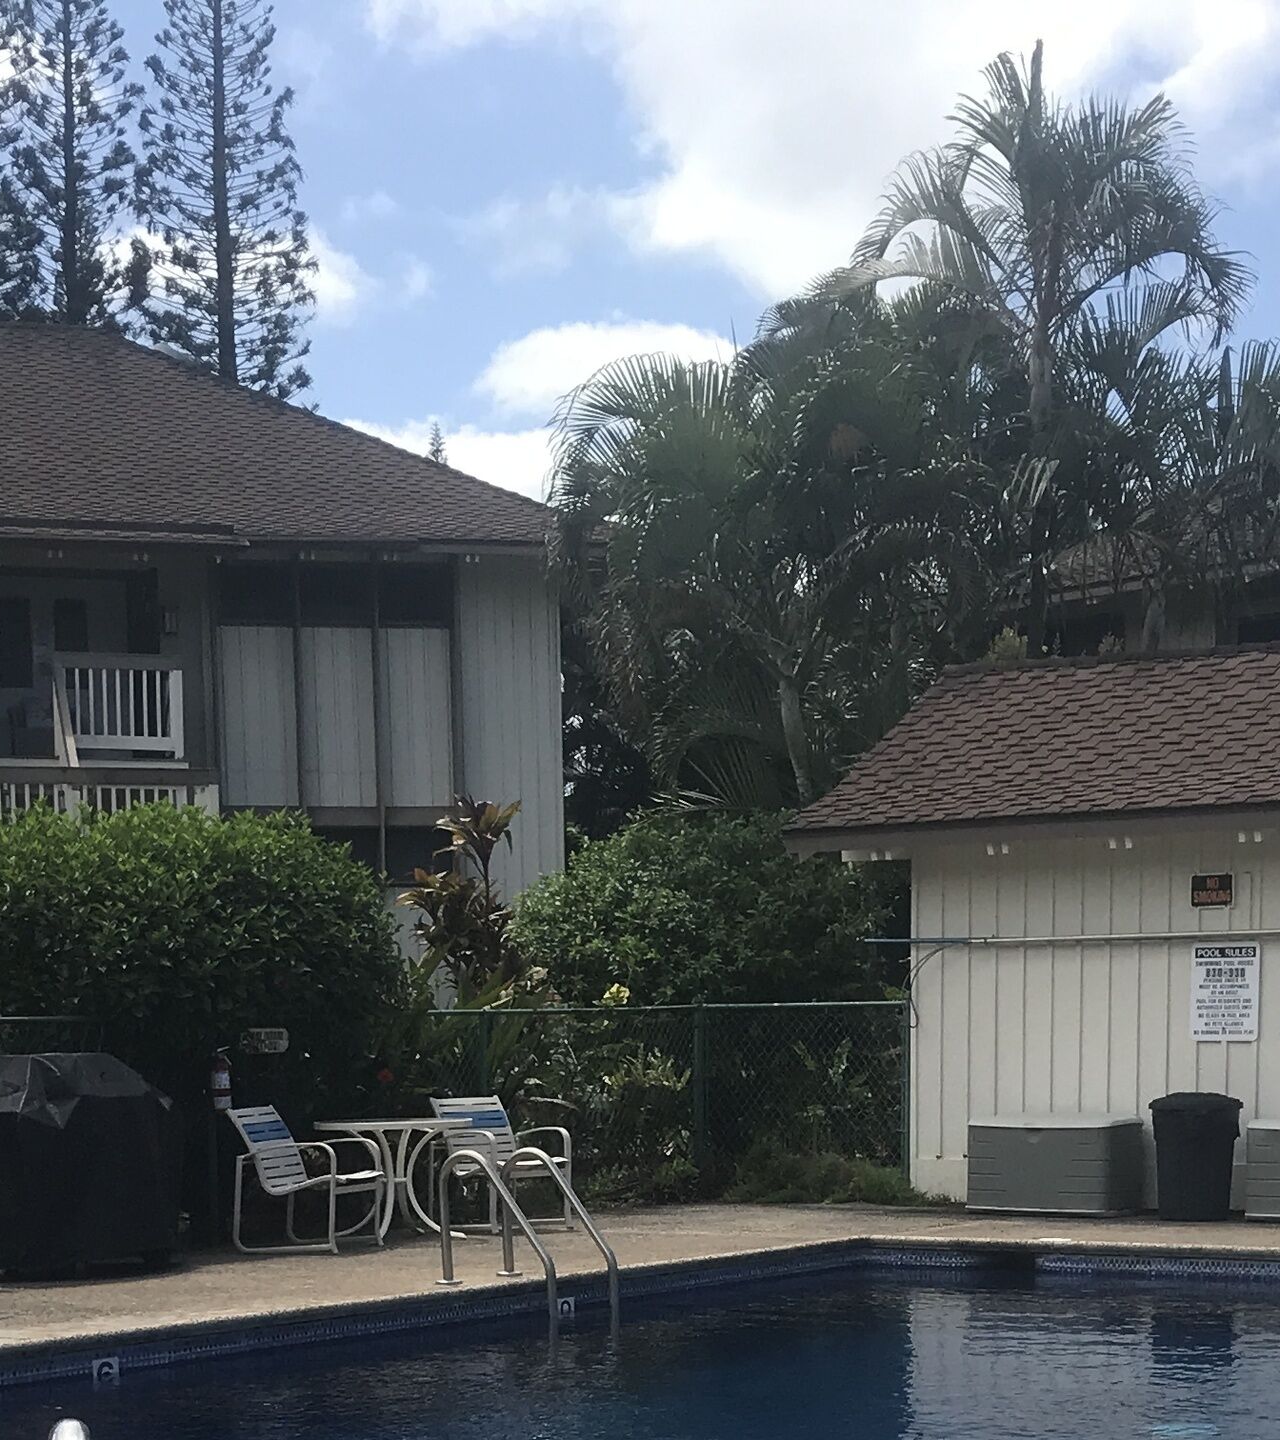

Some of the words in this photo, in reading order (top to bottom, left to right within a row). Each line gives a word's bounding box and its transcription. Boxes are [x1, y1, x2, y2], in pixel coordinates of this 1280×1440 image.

[1207, 877, 1219, 889] NO
[1197, 949, 1221, 957] POOL
[1225, 948, 1254, 957] RULES
